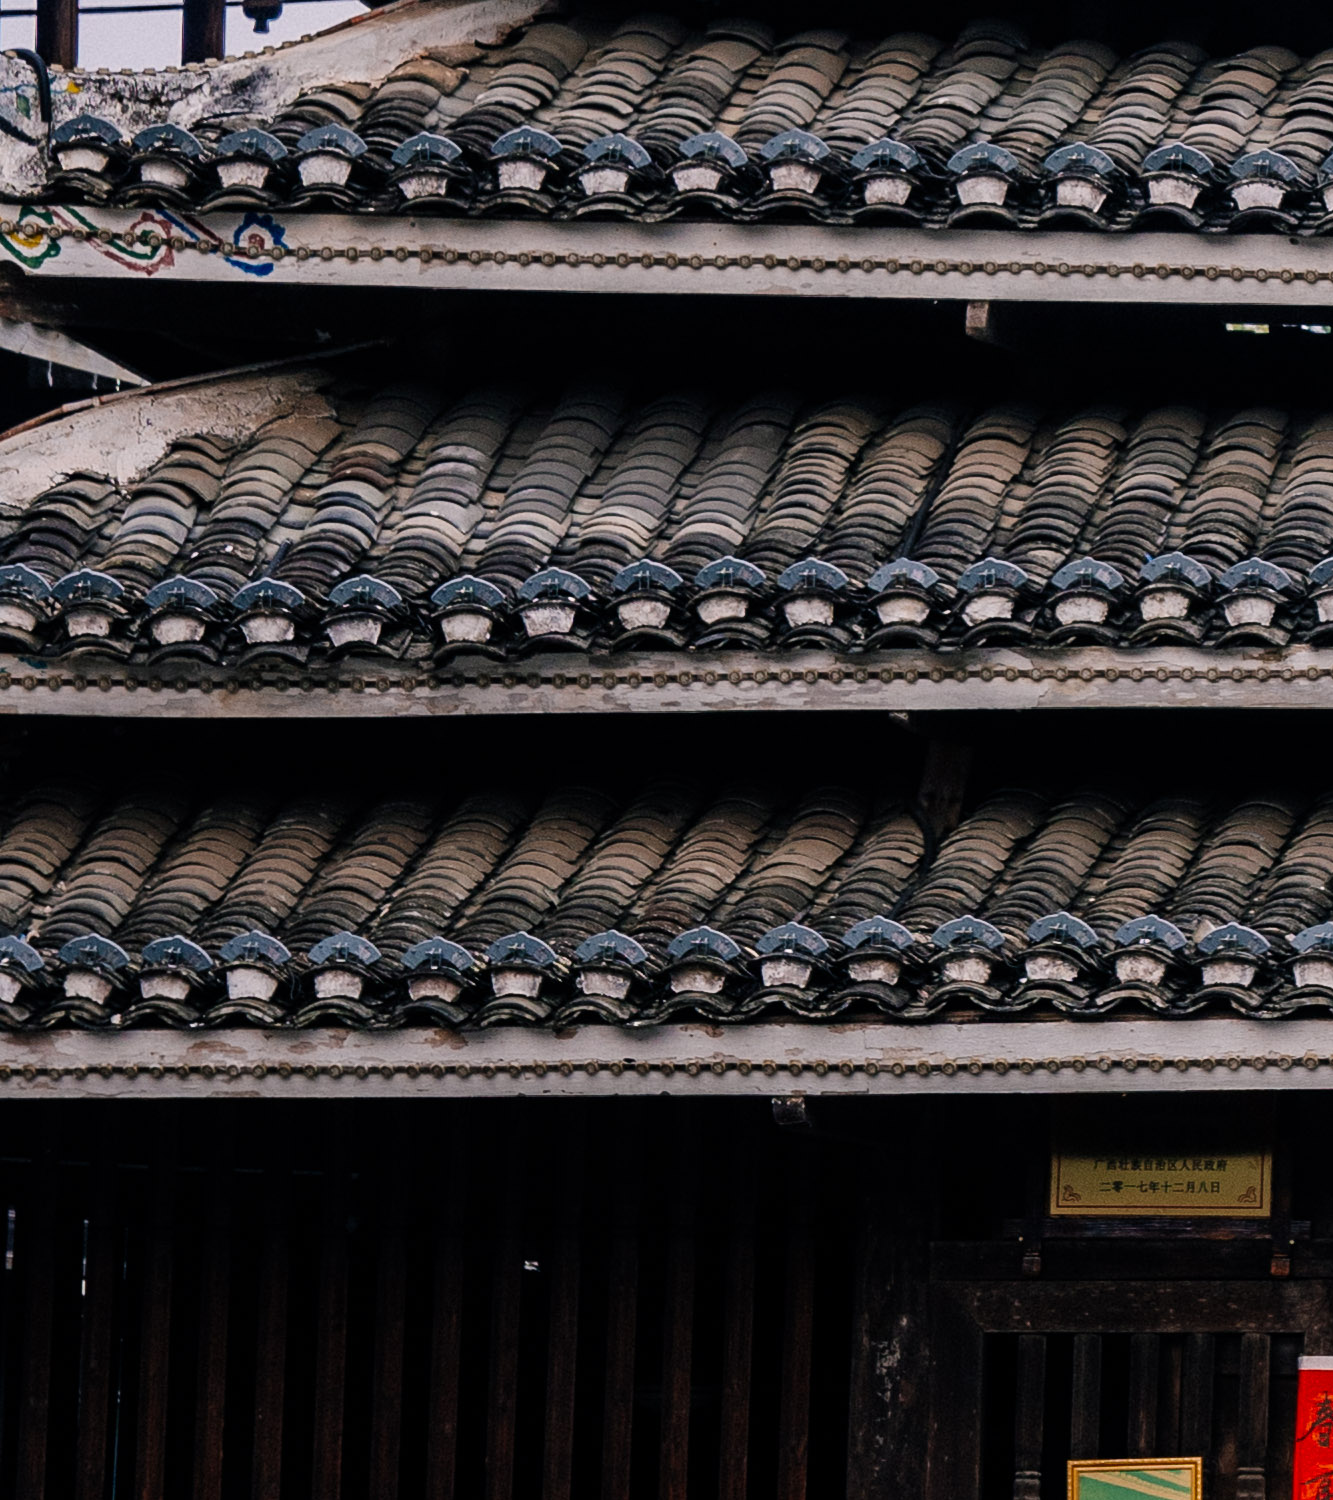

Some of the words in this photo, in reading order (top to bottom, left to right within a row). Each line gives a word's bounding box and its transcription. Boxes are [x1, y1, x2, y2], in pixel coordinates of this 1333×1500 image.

[1093, 1158, 1228, 1172] 广西壮族自治区人民政府
[1099, 1181, 1221, 1194] 二零一七年十二月八日
